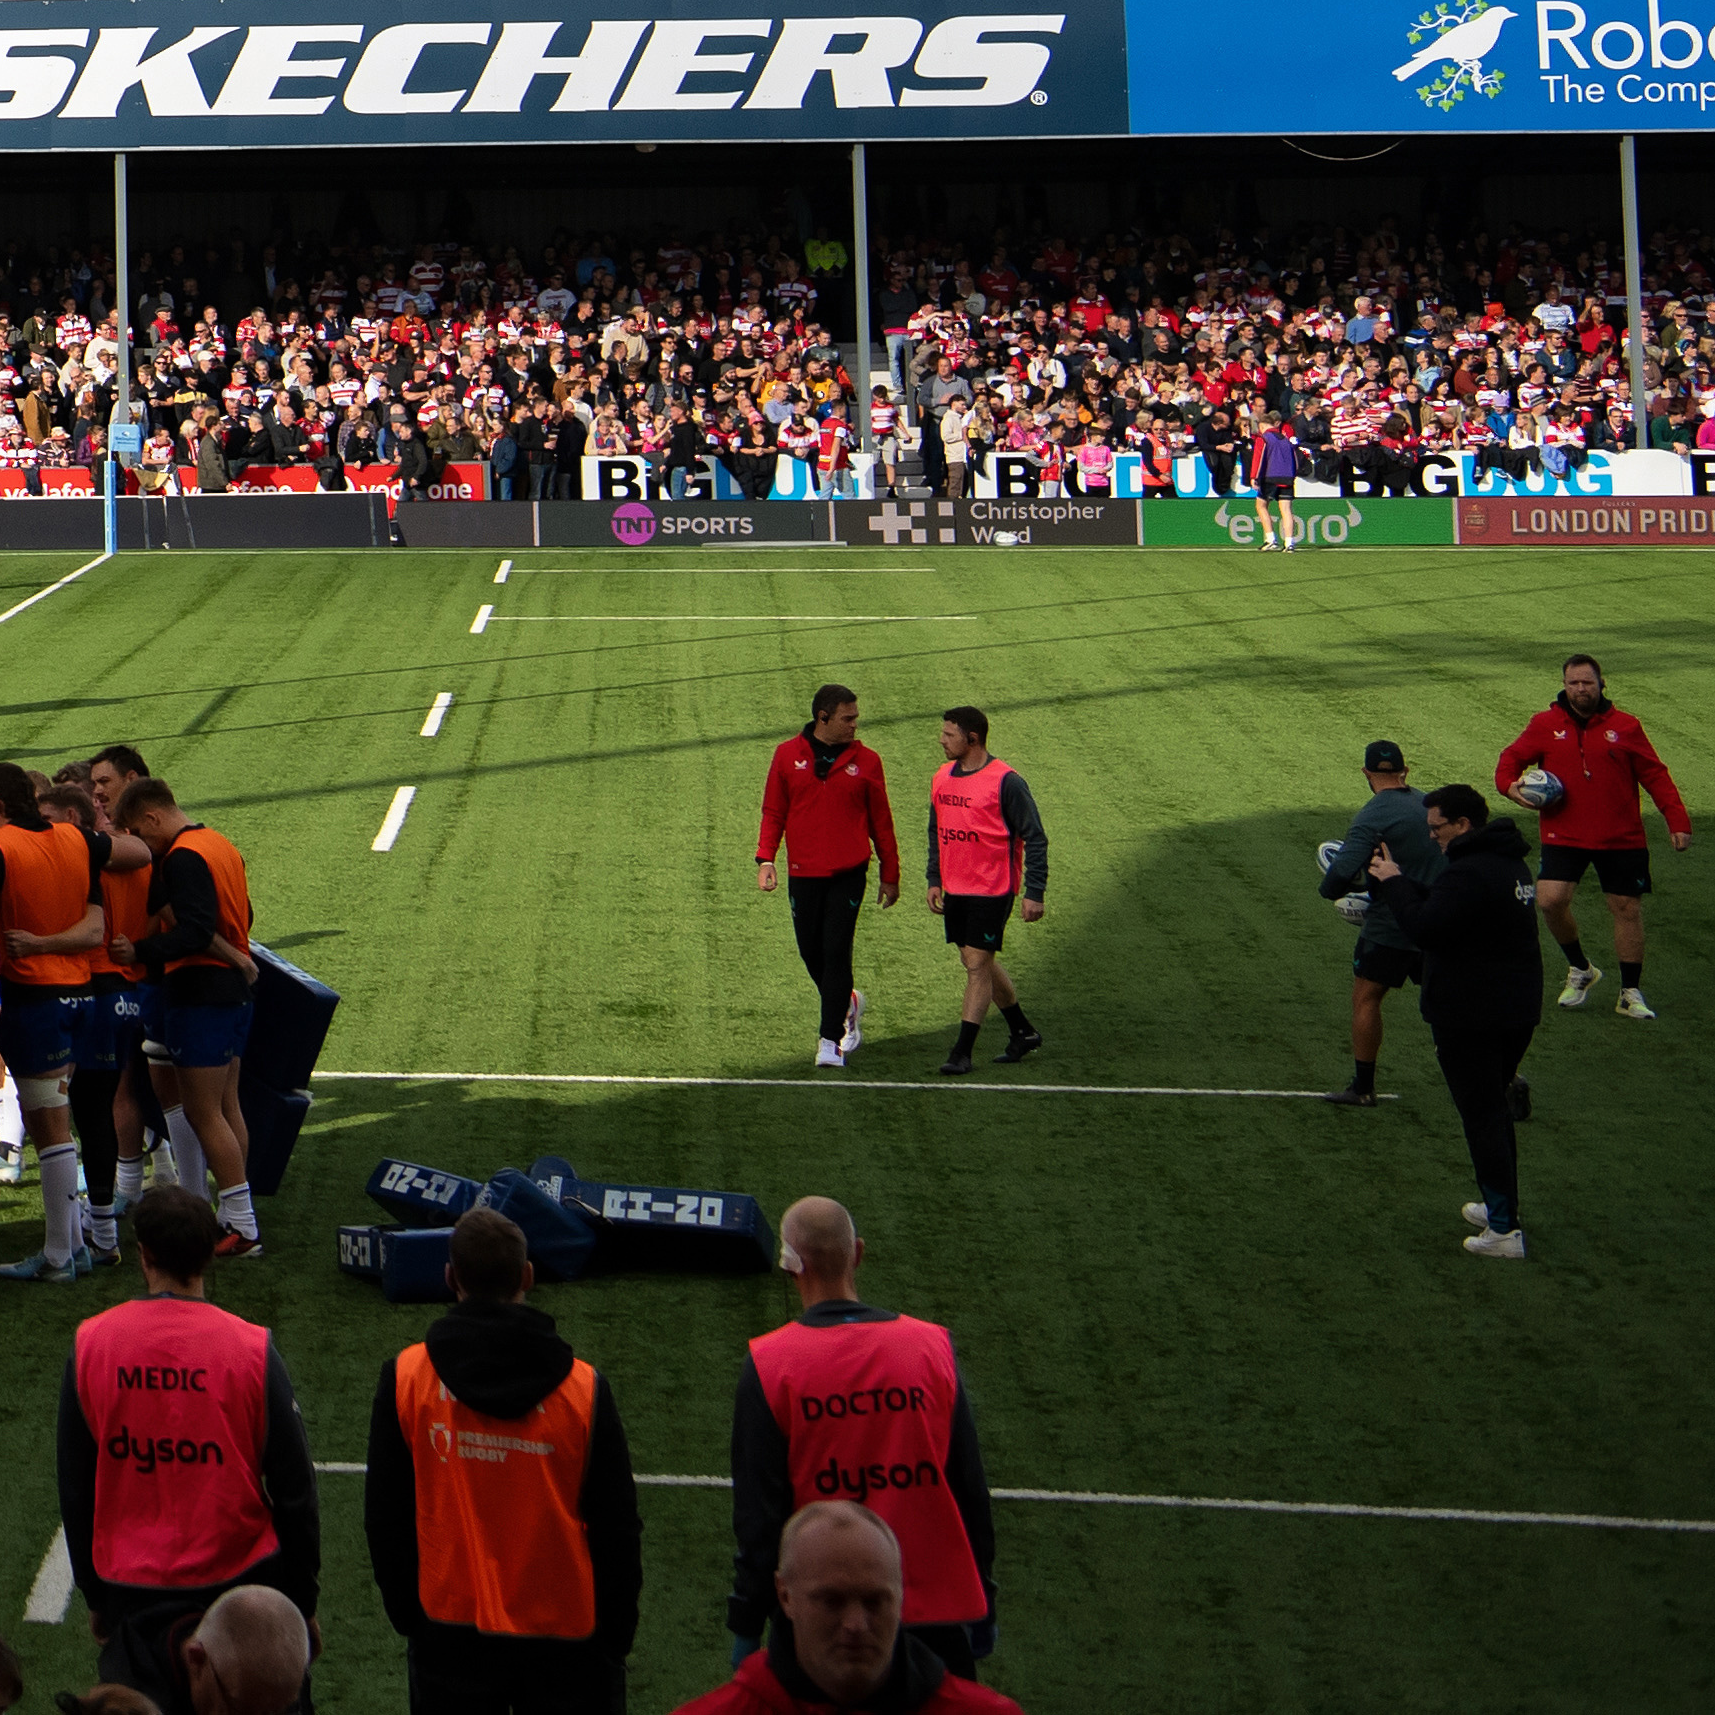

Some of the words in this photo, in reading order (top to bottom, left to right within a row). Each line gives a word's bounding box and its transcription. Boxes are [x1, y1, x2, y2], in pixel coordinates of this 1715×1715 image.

[1540, 75, 1604, 103] The
[612, 517, 656, 534] TNT
[662, 516, 753, 535] SPORTS
[970, 501, 1105, 524] Christopher
[1511, 508, 1632, 534] LONDON
[938, 794, 973, 808] MEDIC
[603, 1189, 724, 1227] RHINO
[117, 1366, 207, 1393] MEDIC
[800, 1385, 928, 1423] DOCTOR
[107, 1426, 224, 1474] dyson
[457, 1445, 509, 1464] RUGBY
[815, 1457, 940, 1503] dyson
